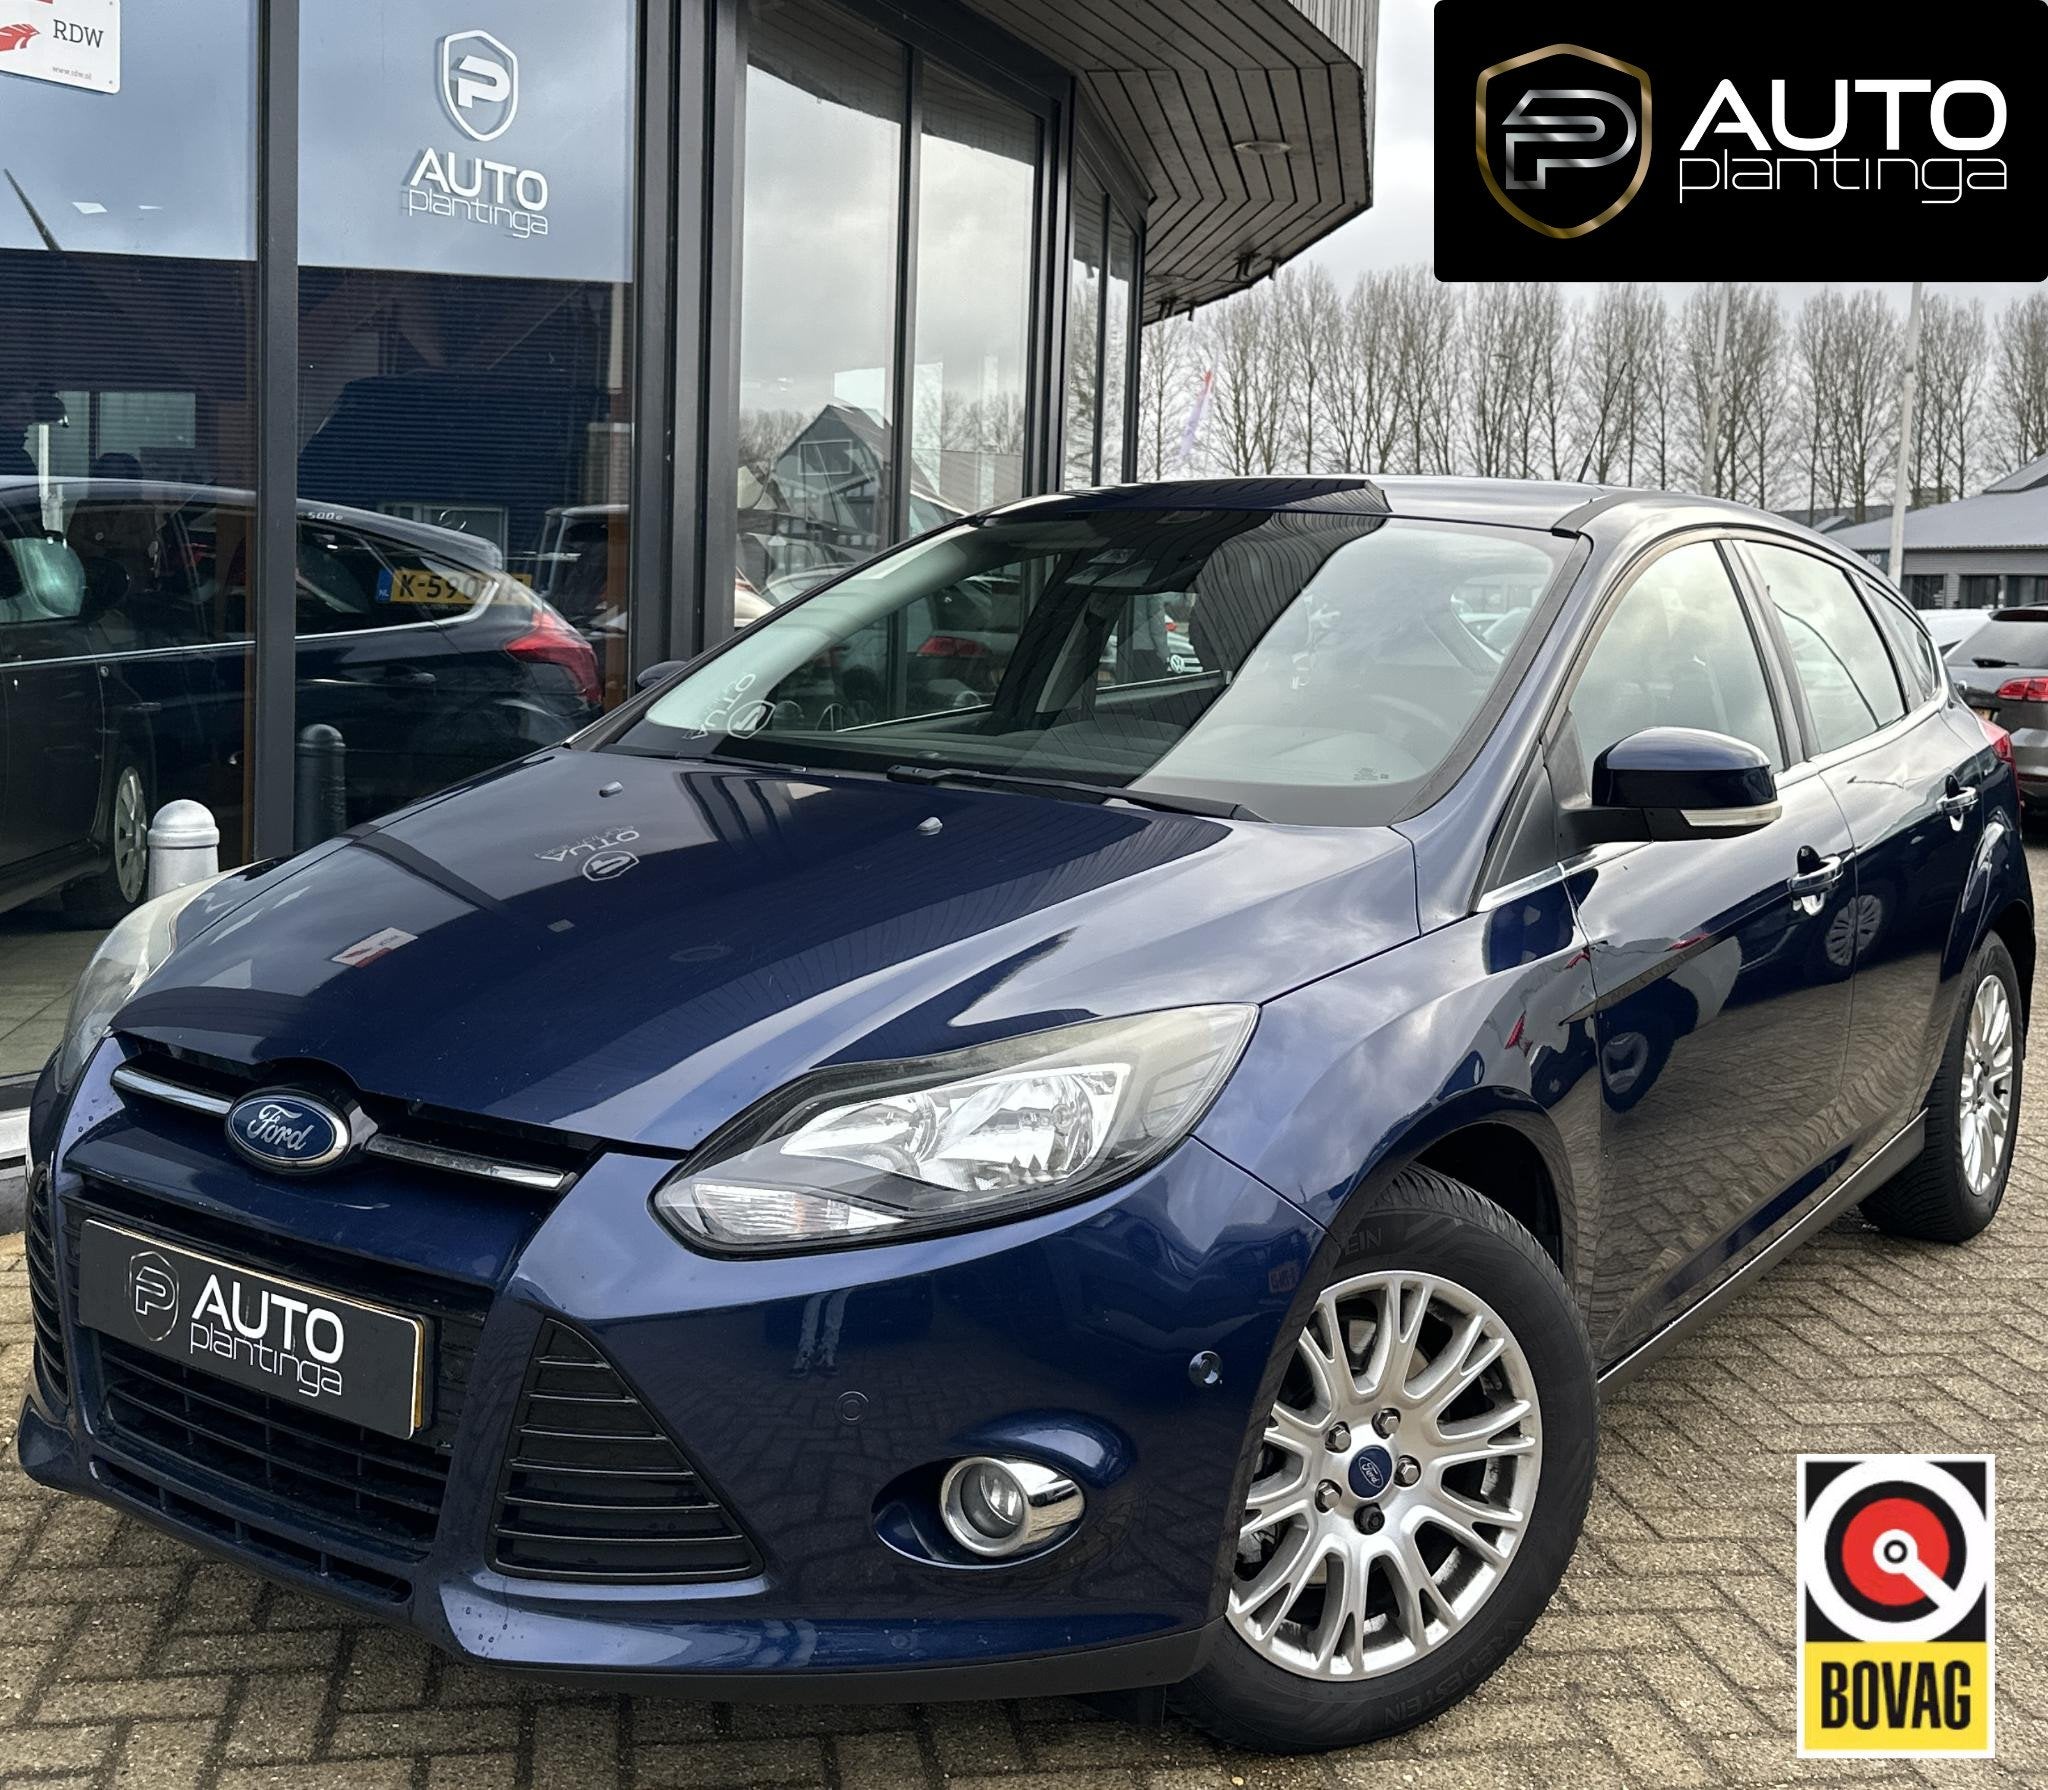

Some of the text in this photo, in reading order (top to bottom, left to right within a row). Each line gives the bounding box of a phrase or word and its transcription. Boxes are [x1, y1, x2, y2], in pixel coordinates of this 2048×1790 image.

[53, 19, 104, 48] RDW
[410, 147, 548, 211] AUTO
[409, 188, 548, 238] plantinga
[246, 1104, 315, 1151] Ford
[192, 1274, 345, 1364] AUTO
[190, 1322, 342, 1397] plantinga
[1361, 1462, 1380, 1484] Ford
